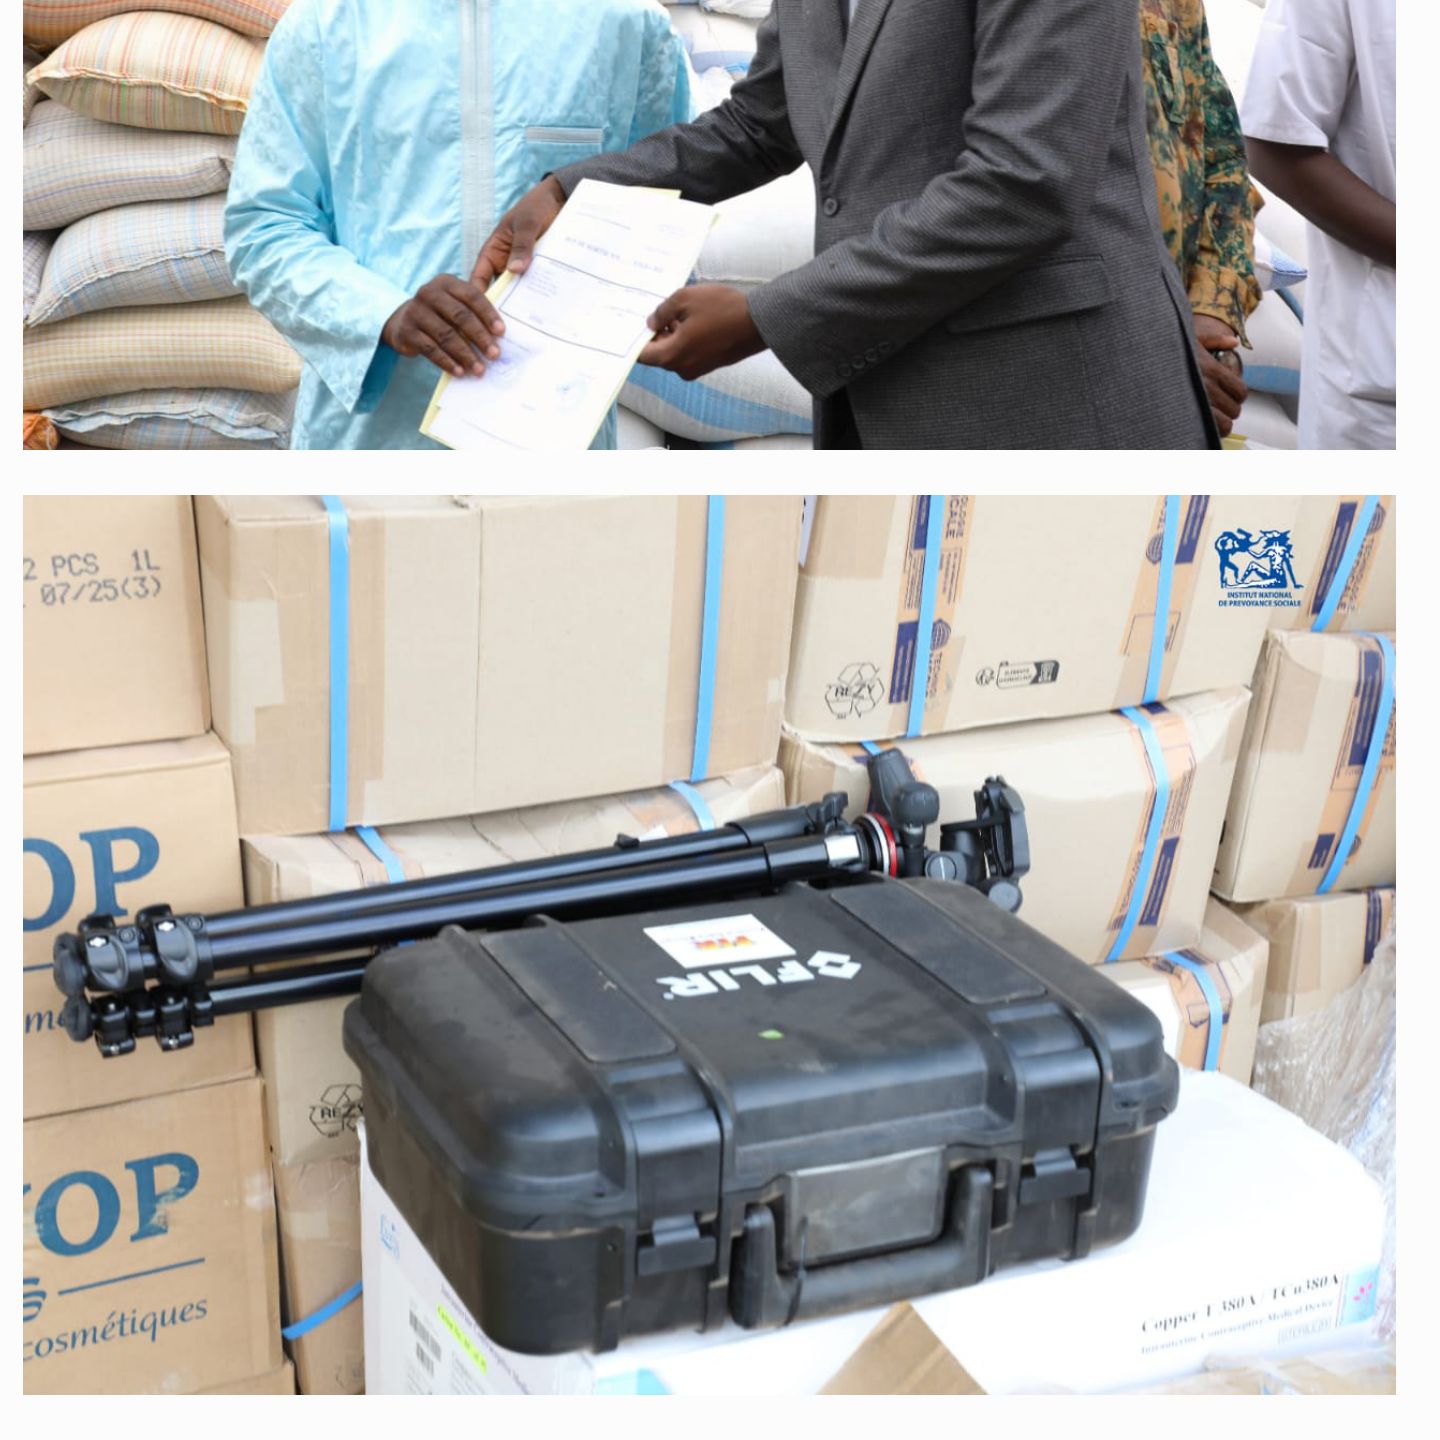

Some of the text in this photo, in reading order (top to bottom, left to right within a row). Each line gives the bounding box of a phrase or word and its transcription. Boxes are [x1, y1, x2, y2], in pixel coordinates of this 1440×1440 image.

[51, 552, 100, 579] PCS
[131, 549, 161, 572] 1L
[40, 575, 162, 607] 07/25(3)
[656, 959, 816, 998] FLIR
[1142, 1310, 1198, 1333] Copper
